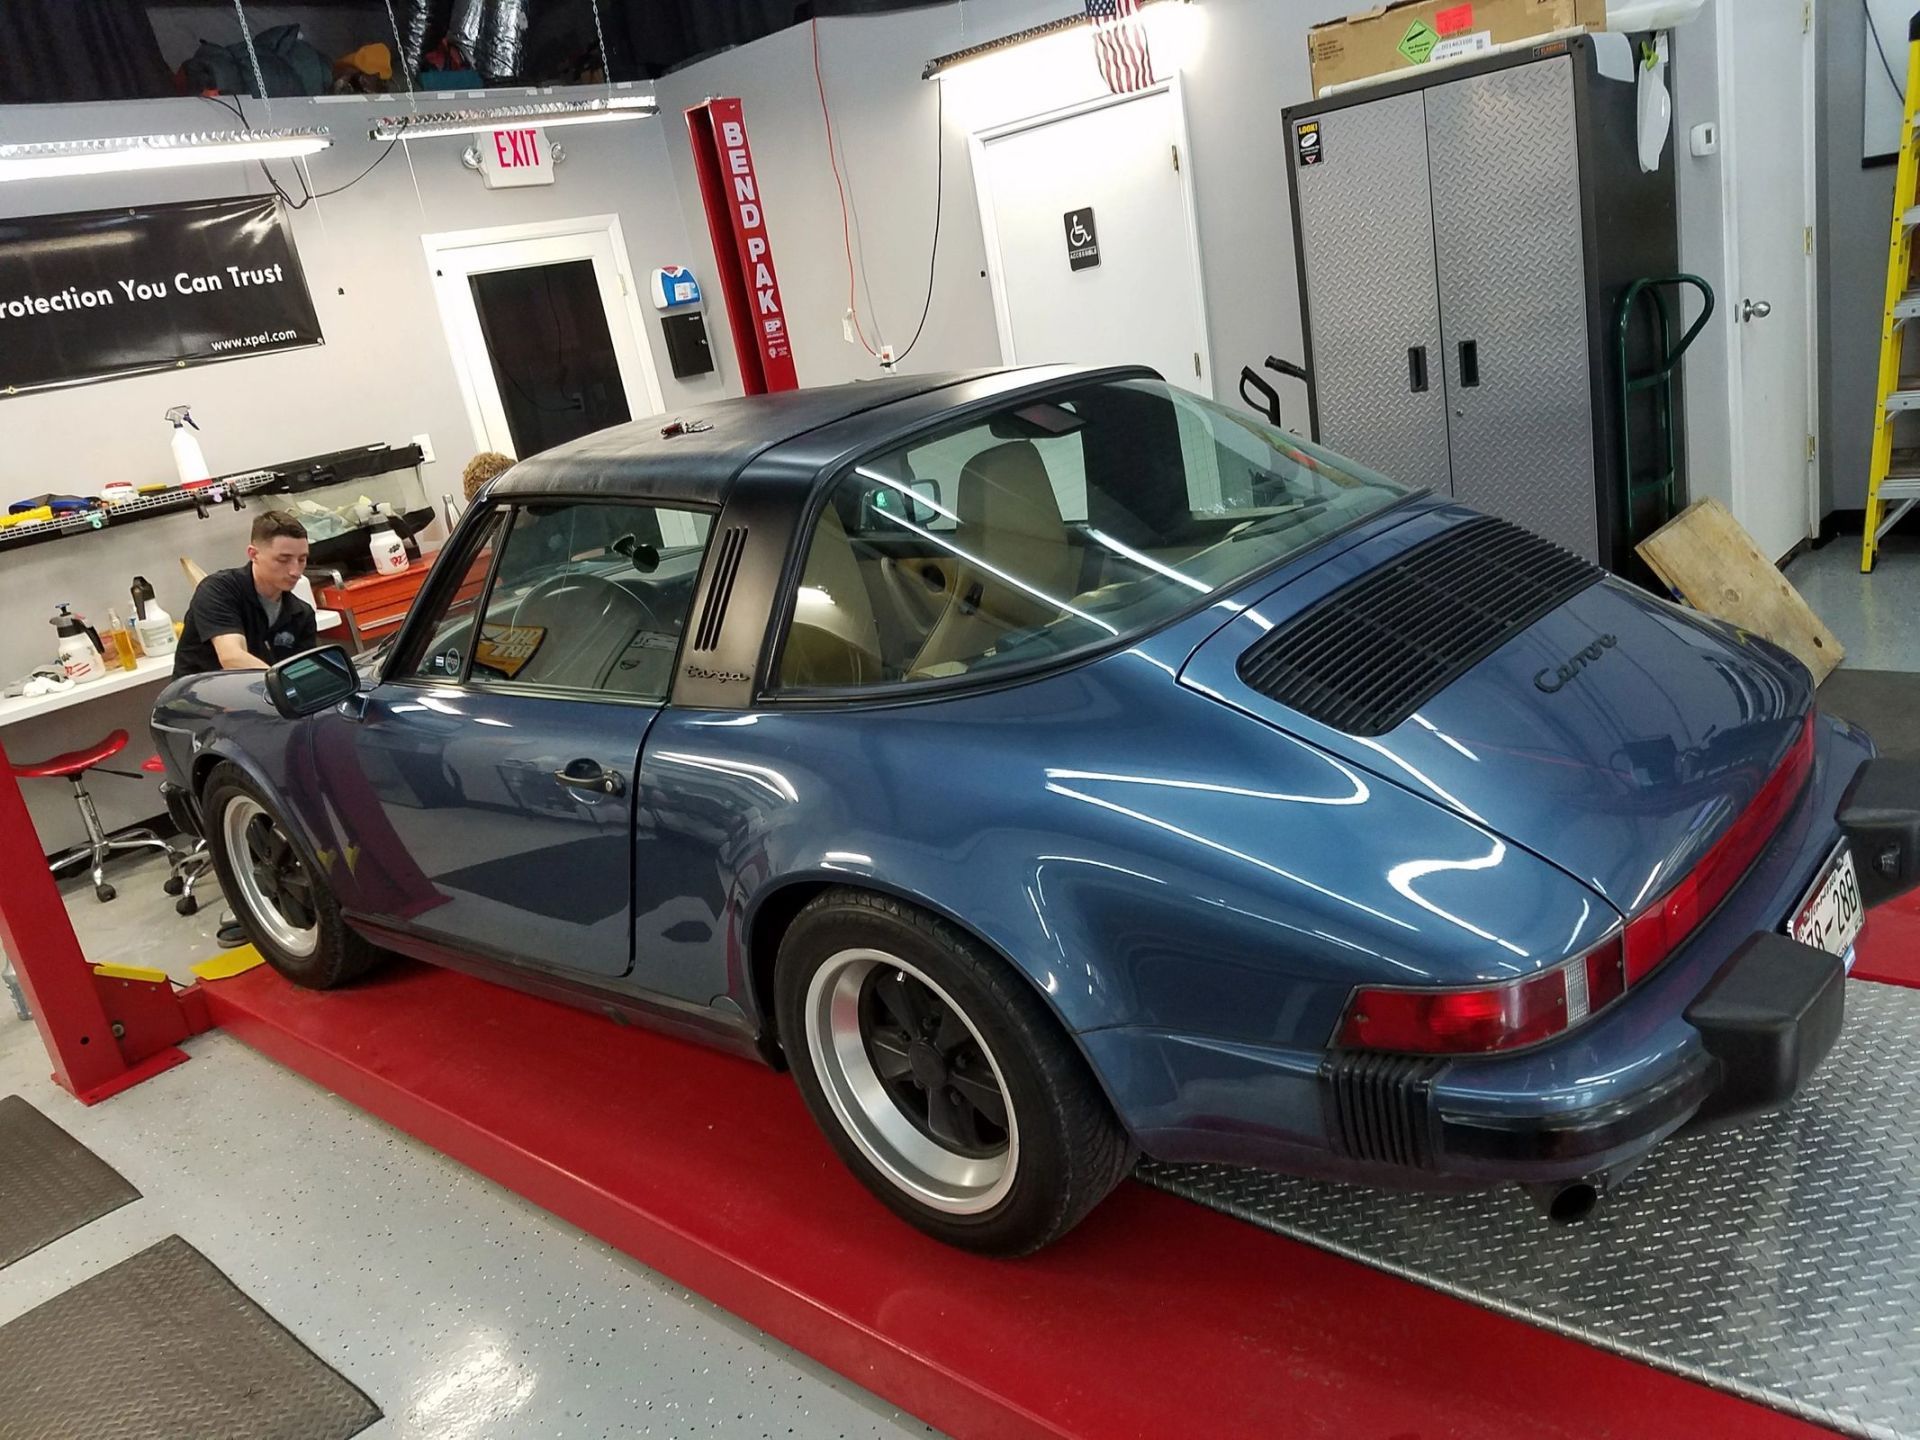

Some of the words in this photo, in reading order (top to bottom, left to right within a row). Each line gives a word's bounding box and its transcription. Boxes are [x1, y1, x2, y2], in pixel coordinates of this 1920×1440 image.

[1298, 122, 1318, 134] LOOK!
[493, 129, 539, 168] EXIT
[0, 286, 114, 319] rotection
[117, 279, 168, 301] You
[174, 272, 223, 295] Can
[226, 263, 284, 288] Trust
[210, 328, 298, 351] www.xpel.com
